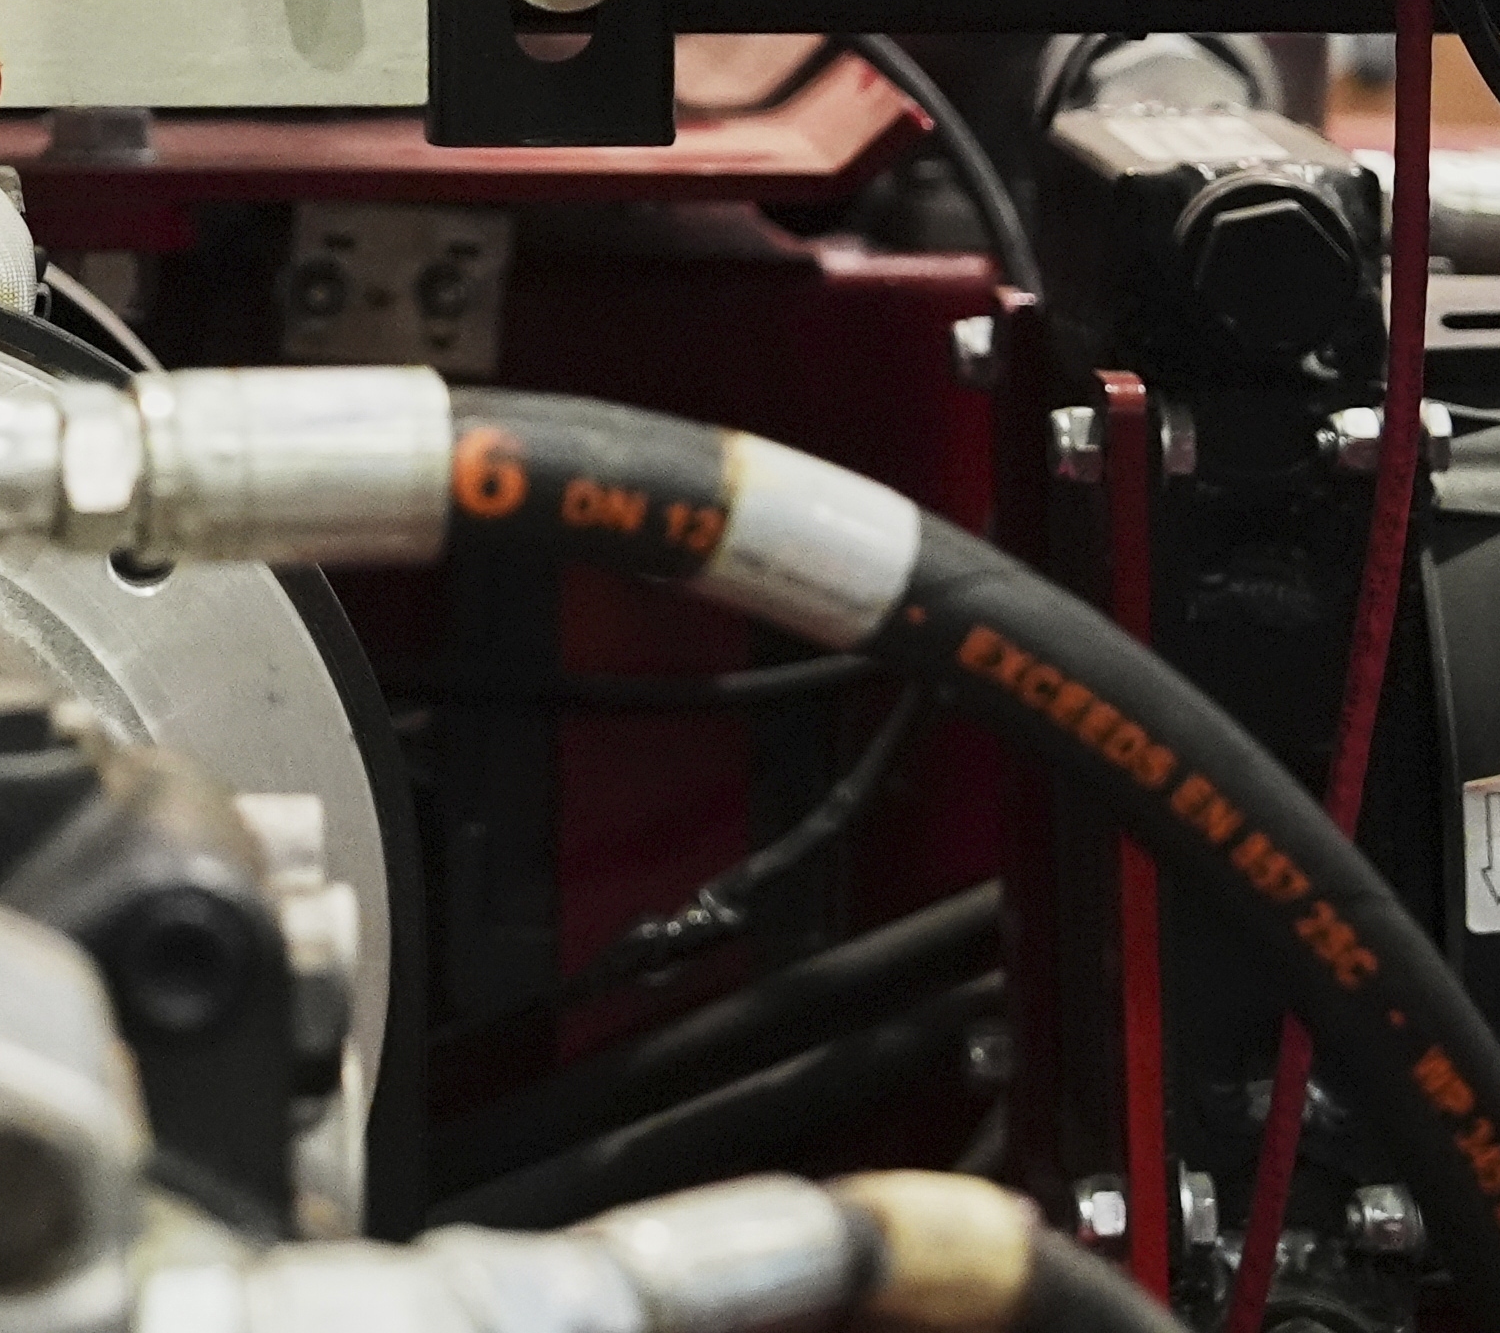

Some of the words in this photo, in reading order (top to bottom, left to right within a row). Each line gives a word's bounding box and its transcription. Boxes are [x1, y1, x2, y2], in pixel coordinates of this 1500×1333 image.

[450, 427, 530, 518] 6
[958, 625, 1178, 791] EXCEEDS
[1170, 773, 1242, 845] EN
